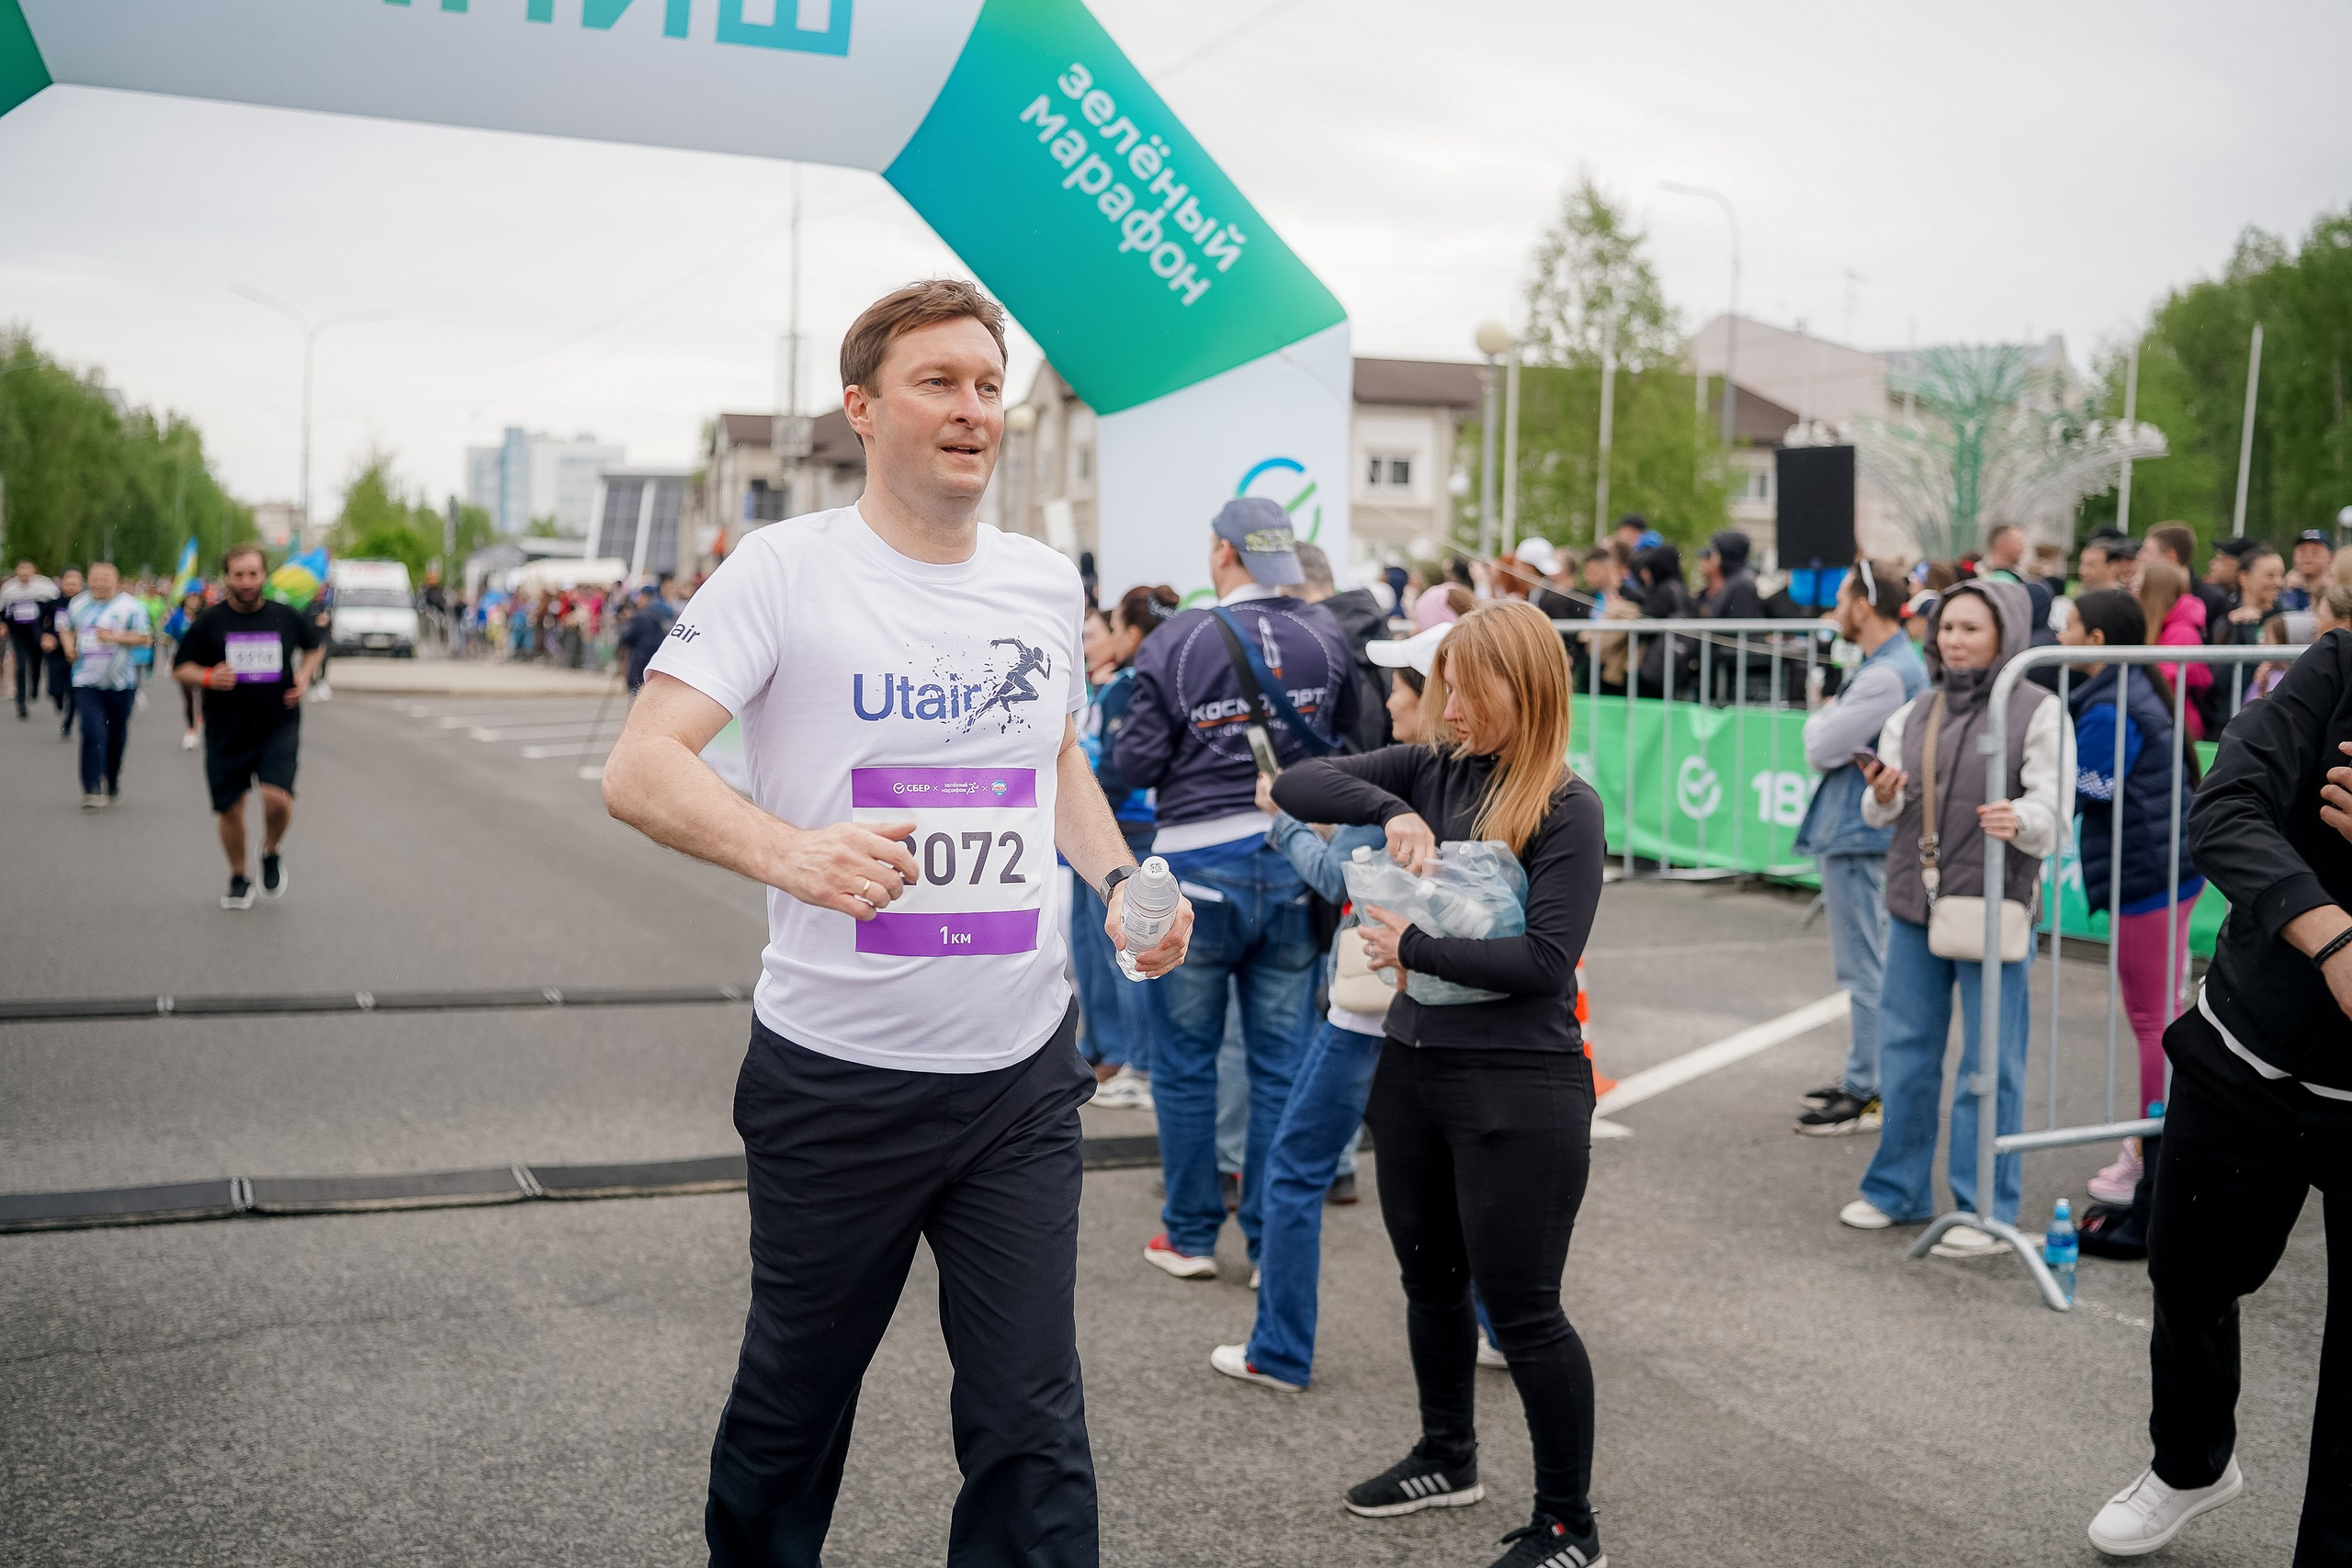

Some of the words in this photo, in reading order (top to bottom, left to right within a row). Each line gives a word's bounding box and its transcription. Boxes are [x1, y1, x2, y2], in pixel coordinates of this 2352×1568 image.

[1057, 62, 1248, 273] зелёный
[1019, 94, 1211, 307] марафон
[670, 623, 701, 643] air
[854, 673, 982, 722] Utair
[906, 784, 931, 793] СБЕР
[1751, 770, 1820, 827] 18
